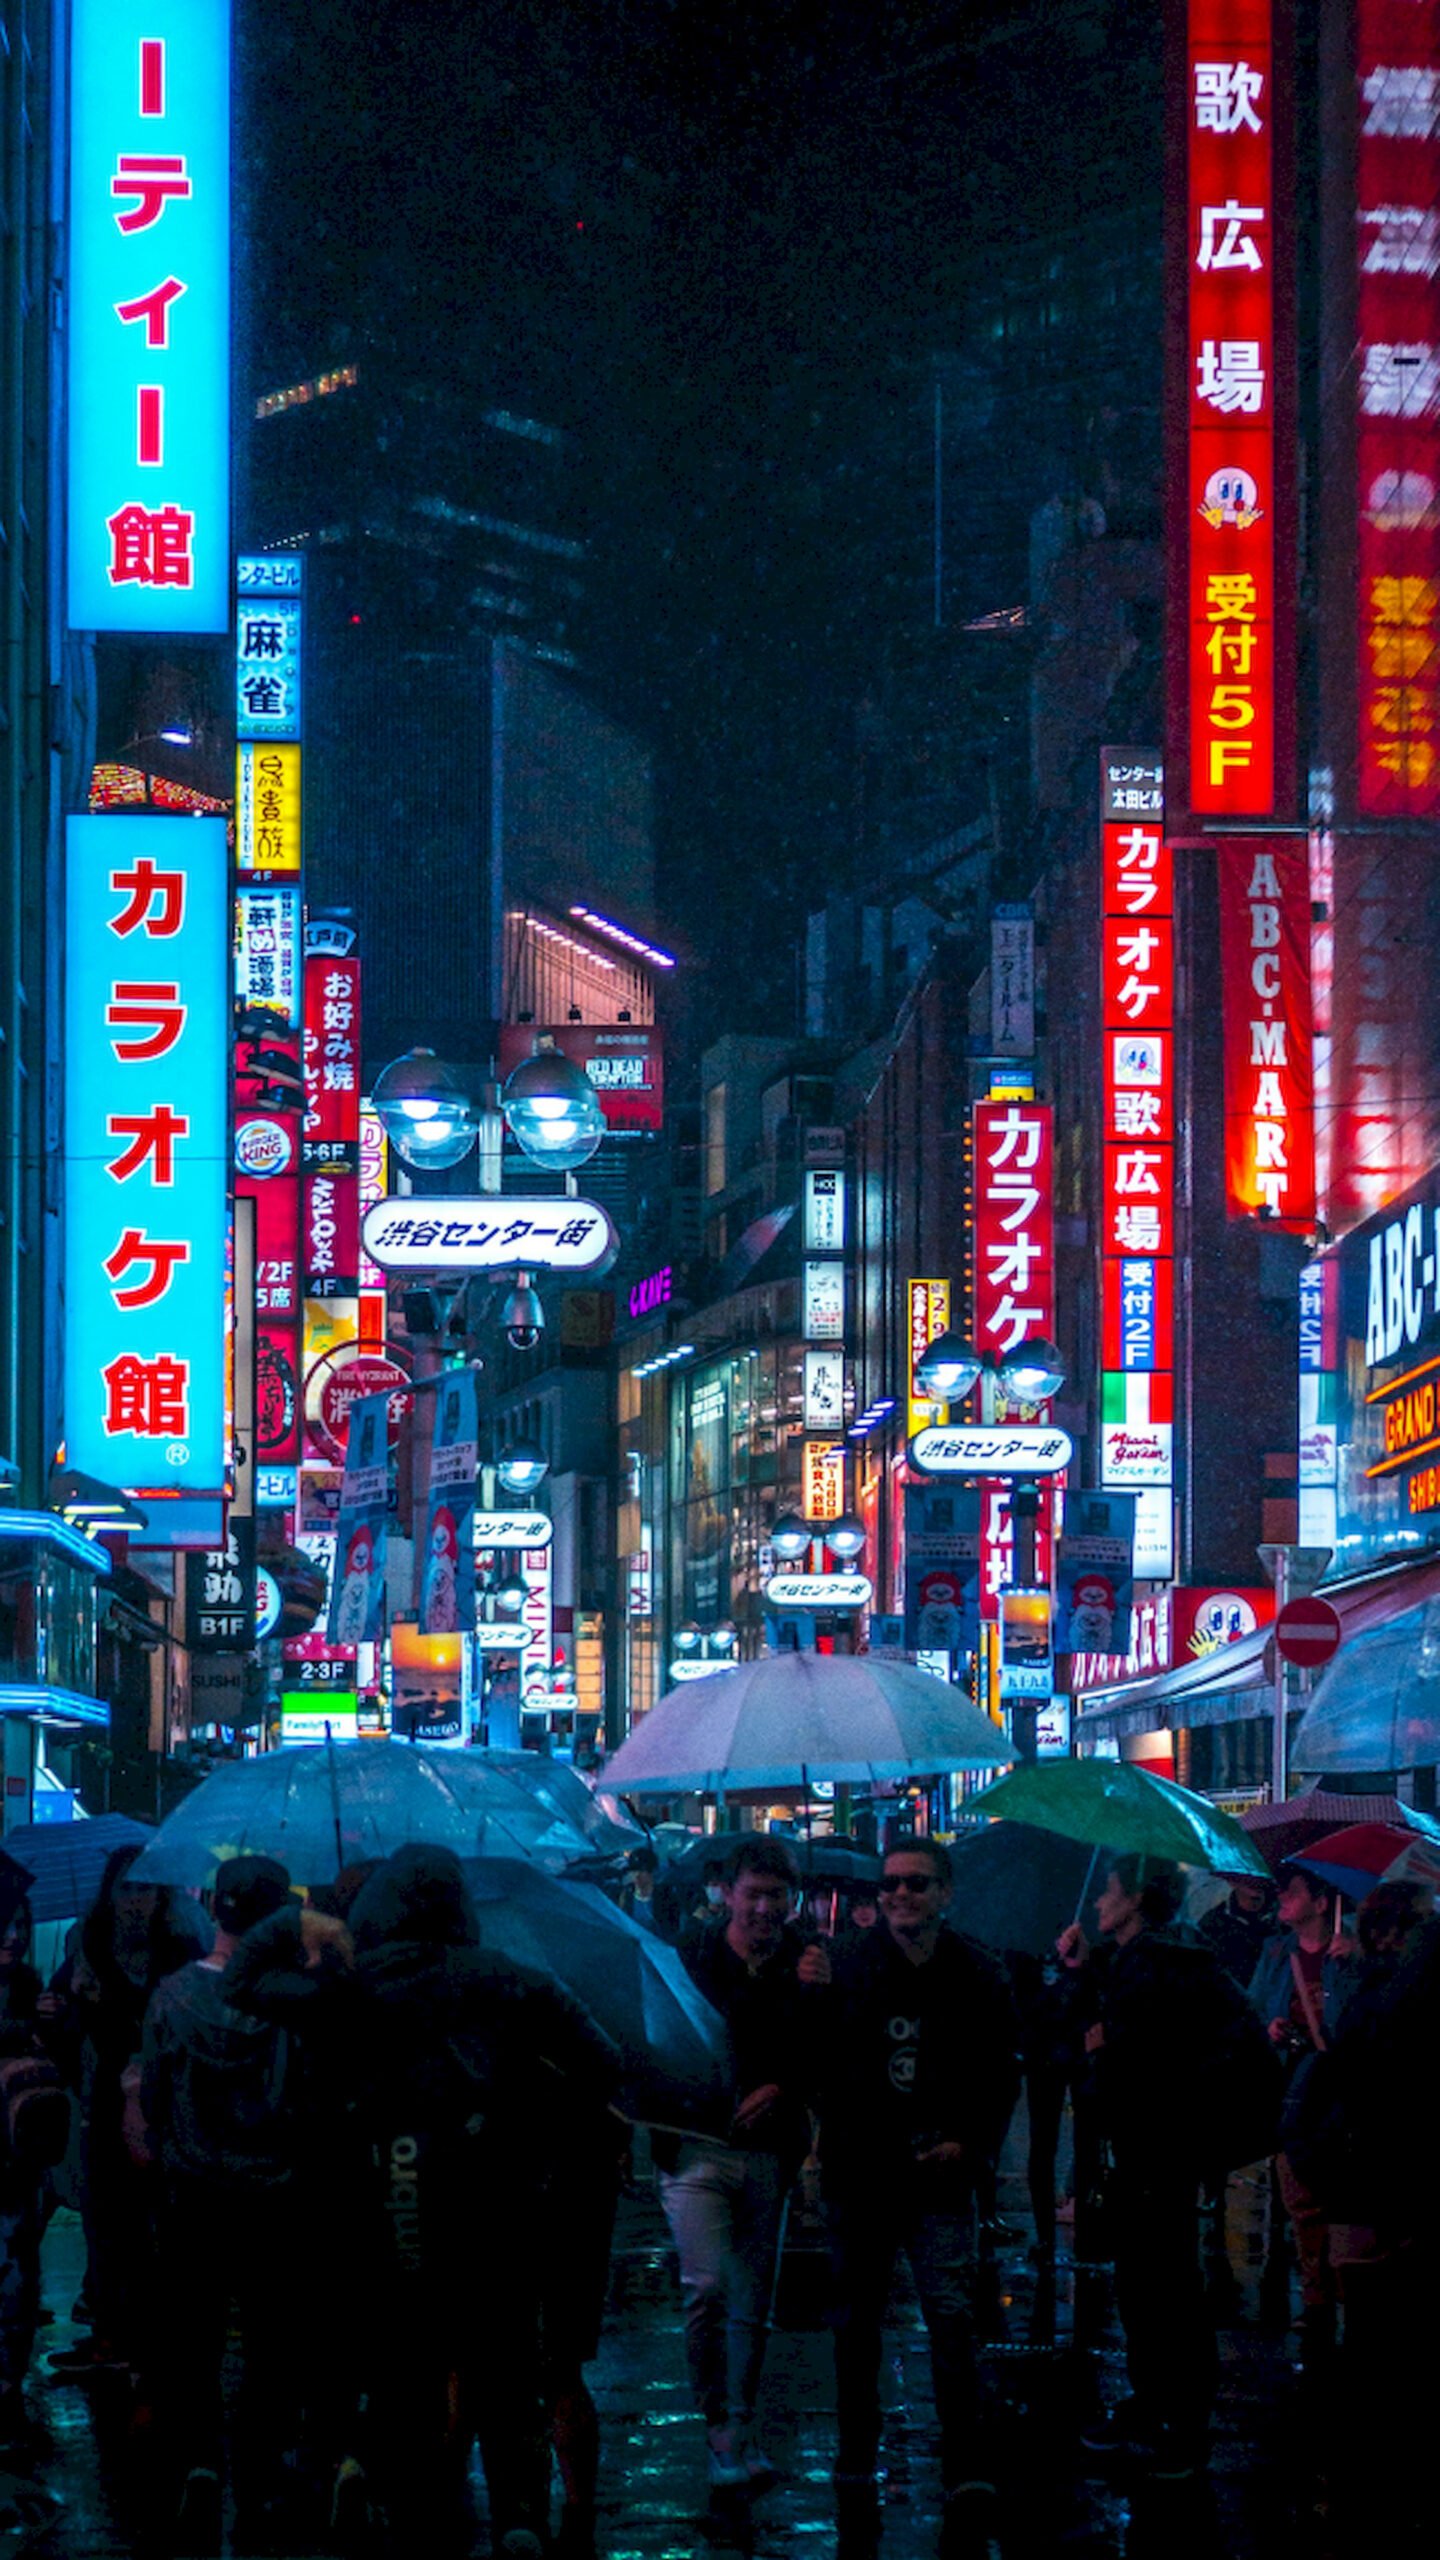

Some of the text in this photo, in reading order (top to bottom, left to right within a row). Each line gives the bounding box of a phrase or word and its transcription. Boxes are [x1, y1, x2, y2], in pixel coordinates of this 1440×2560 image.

[1193, 60, 1267, 415] 歌広場
[106, 37, 194, 587] ーティー館
[243, 620, 284, 715] 麻雀
[1206, 573, 1258, 786] 受付5F
[1112, 789, 1163, 810] 太田ビル
[1116, 828, 1160, 1019] カラオケ
[105, 858, 190, 1438] カラオケ館
[243, 1144, 281, 1163] KING
[1114, 1091, 1162, 1250] 歌広場
[375, 1219, 599, 1247] 渋谷センター街
[986, 1108, 1043, 1351] カラオケ
[311, 1279, 335, 1295] 4F
[1123, 1261, 1152, 1366] 受付2F
[1366, 1204, 1440, 1367] ABC-
[920, 1440, 1064, 1458] 渋谷センター街
[1386, 1383, 1434, 1453] GRAND
[201, 1617, 244, 1636] B1F
[192, 1675, 240, 1688] SUSHI
